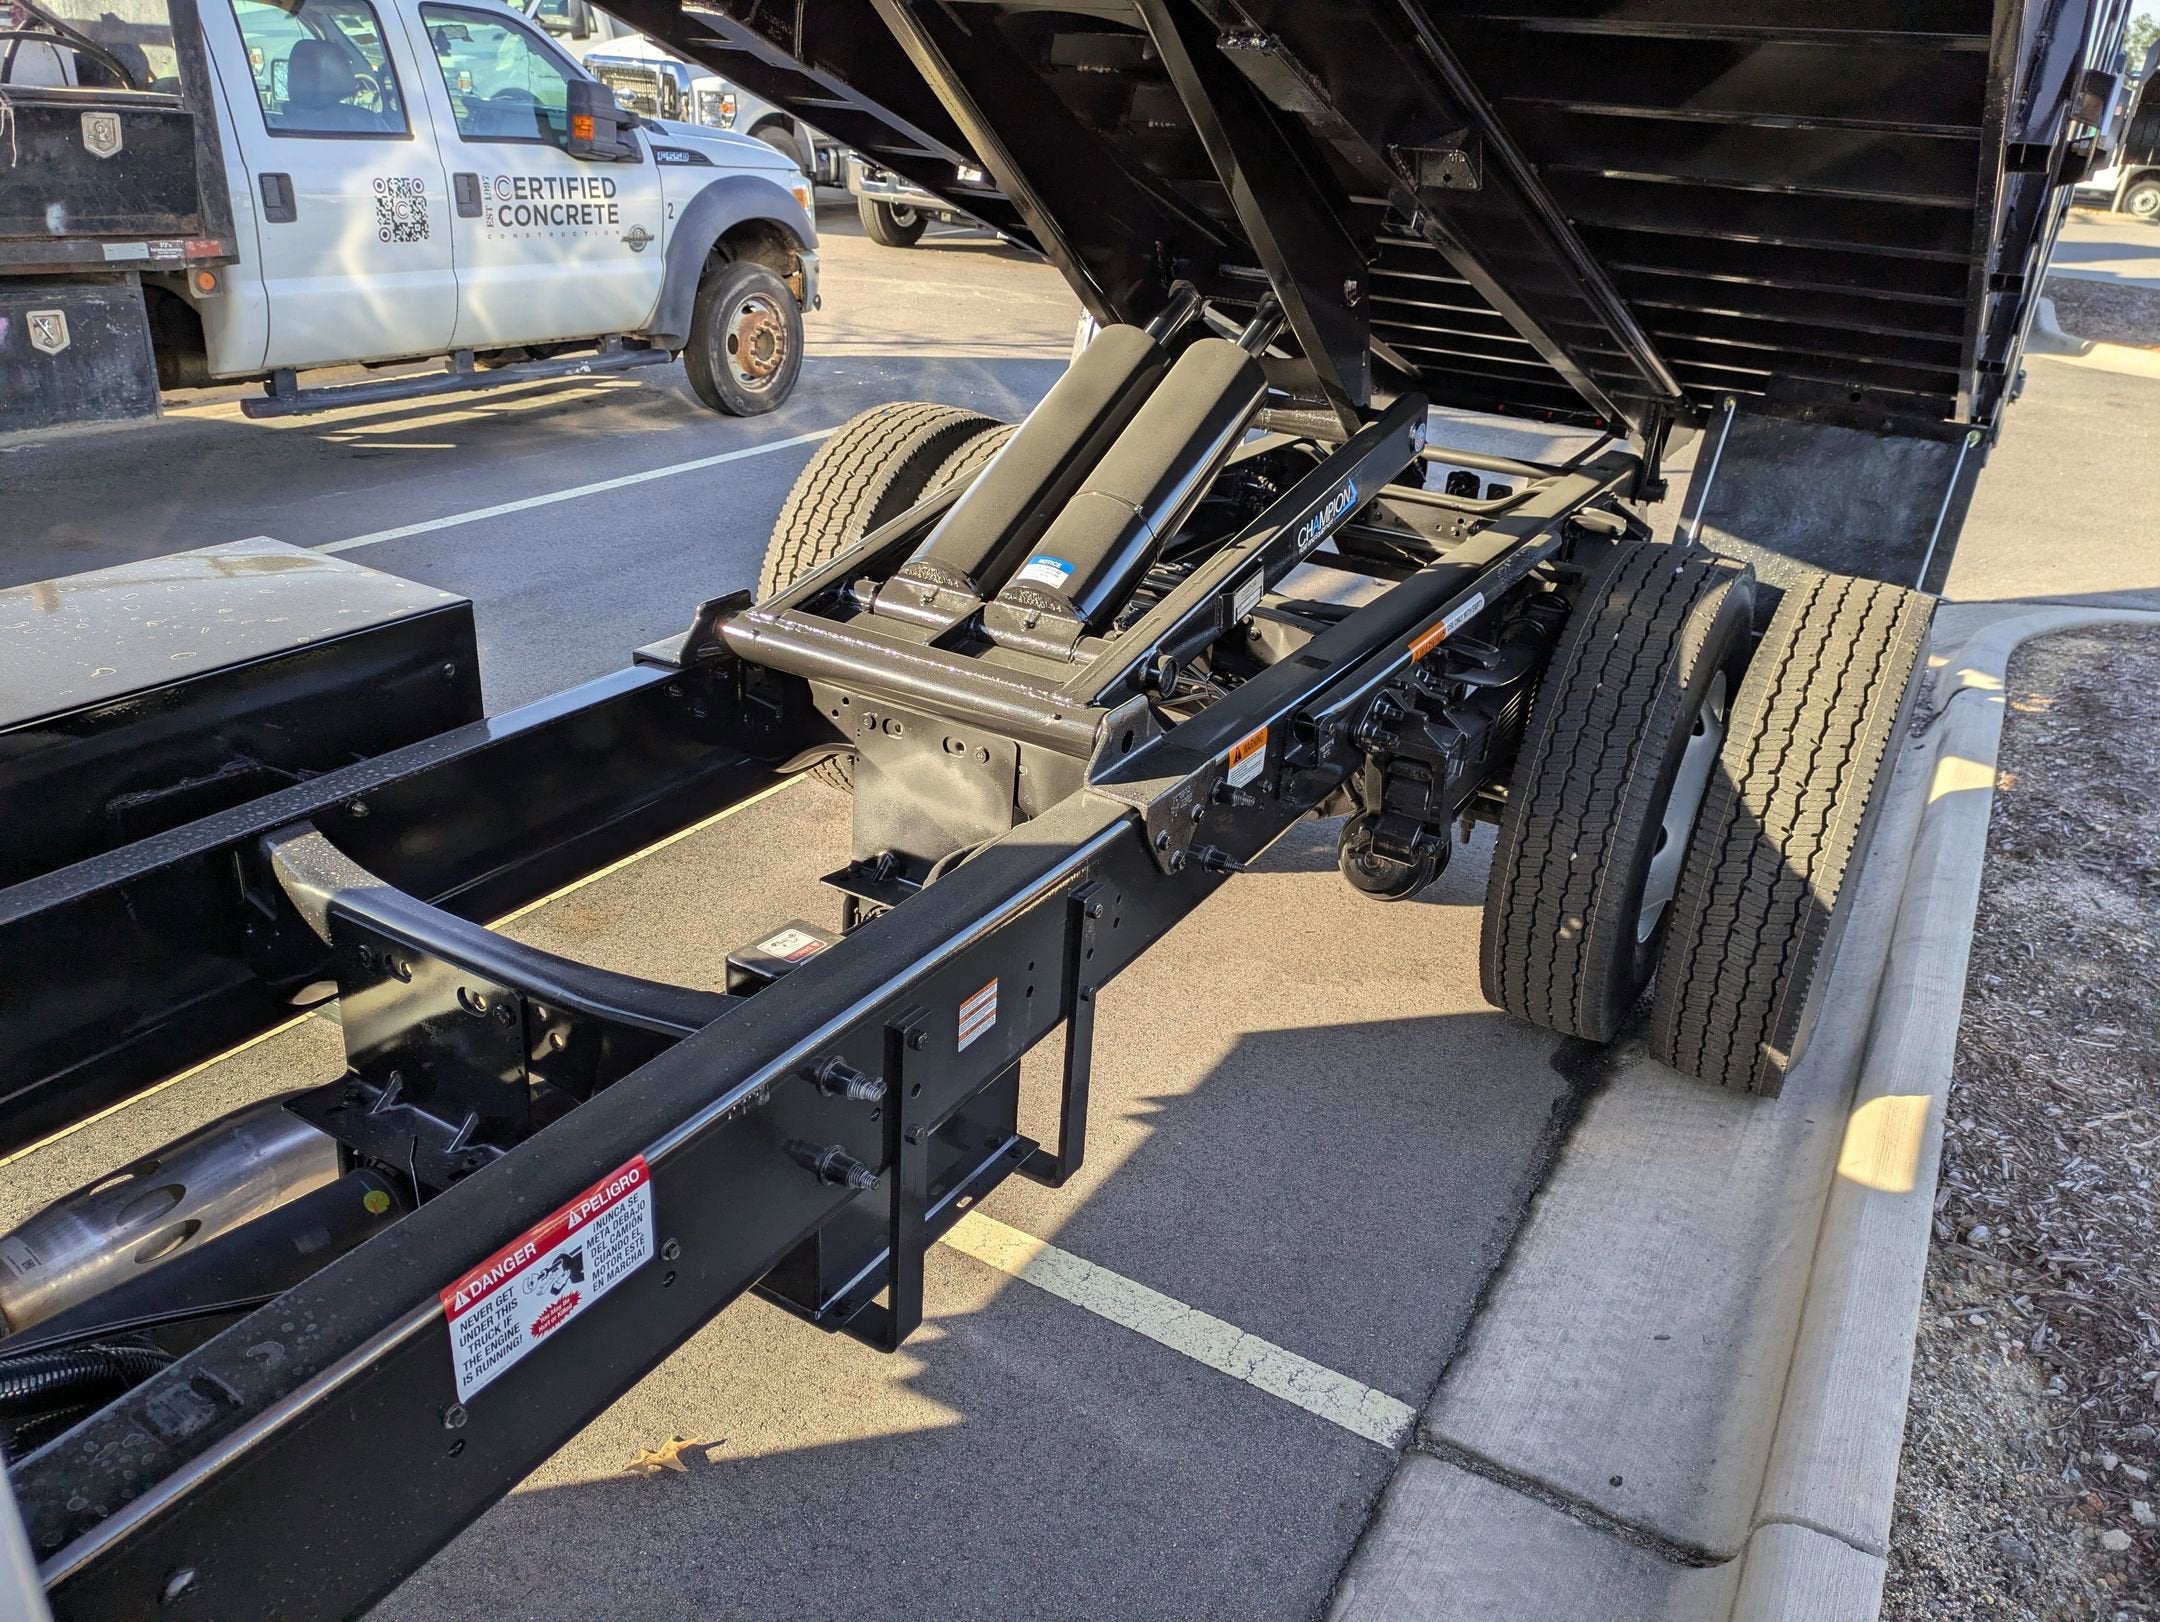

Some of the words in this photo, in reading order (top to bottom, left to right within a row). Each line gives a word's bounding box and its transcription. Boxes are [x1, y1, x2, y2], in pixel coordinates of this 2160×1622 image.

[494, 175, 617, 202] CERTIFIED
[485, 205, 495, 228] EST
[498, 203, 619, 227] CONCRETE
[667, 202, 675, 220] 2
[487, 230, 620, 240] CONSTRUCTION
[1297, 485, 1351, 548] CHAMPION
[1243, 731, 1264, 754] WARNING
[581, 1168, 640, 1219] PELIGRO
[628, 1192, 640, 1207] SE
[586, 1228, 611, 1250] META
[612, 1199, 646, 1230] DEBAJO
[591, 1244, 608, 1258] DEL
[610, 1213, 644, 1244] CAMIÓN
[592, 1252, 622, 1281] MOTOR
[594, 1235, 629, 1268] CUANDO
[631, 1227, 642, 1239] EL
[469, 1242, 537, 1298] DANGER
[592, 1279, 604, 1292] EN
[606, 1247, 646, 1283] MARCHA!
[459, 1316, 494, 1348] UNDER
[495, 1298, 518, 1319] THIS
[460, 1302, 493, 1334] NEVER
[495, 1286, 515, 1306] GET
[463, 1352, 483, 1372] THE
[485, 1321, 521, 1357] ENGINE
[467, 1323, 502, 1354] TRUCK
[503, 1314, 513, 1329] IF
[463, 1372, 473, 1387] IS
[475, 1334, 523, 1378] RUNNING!
